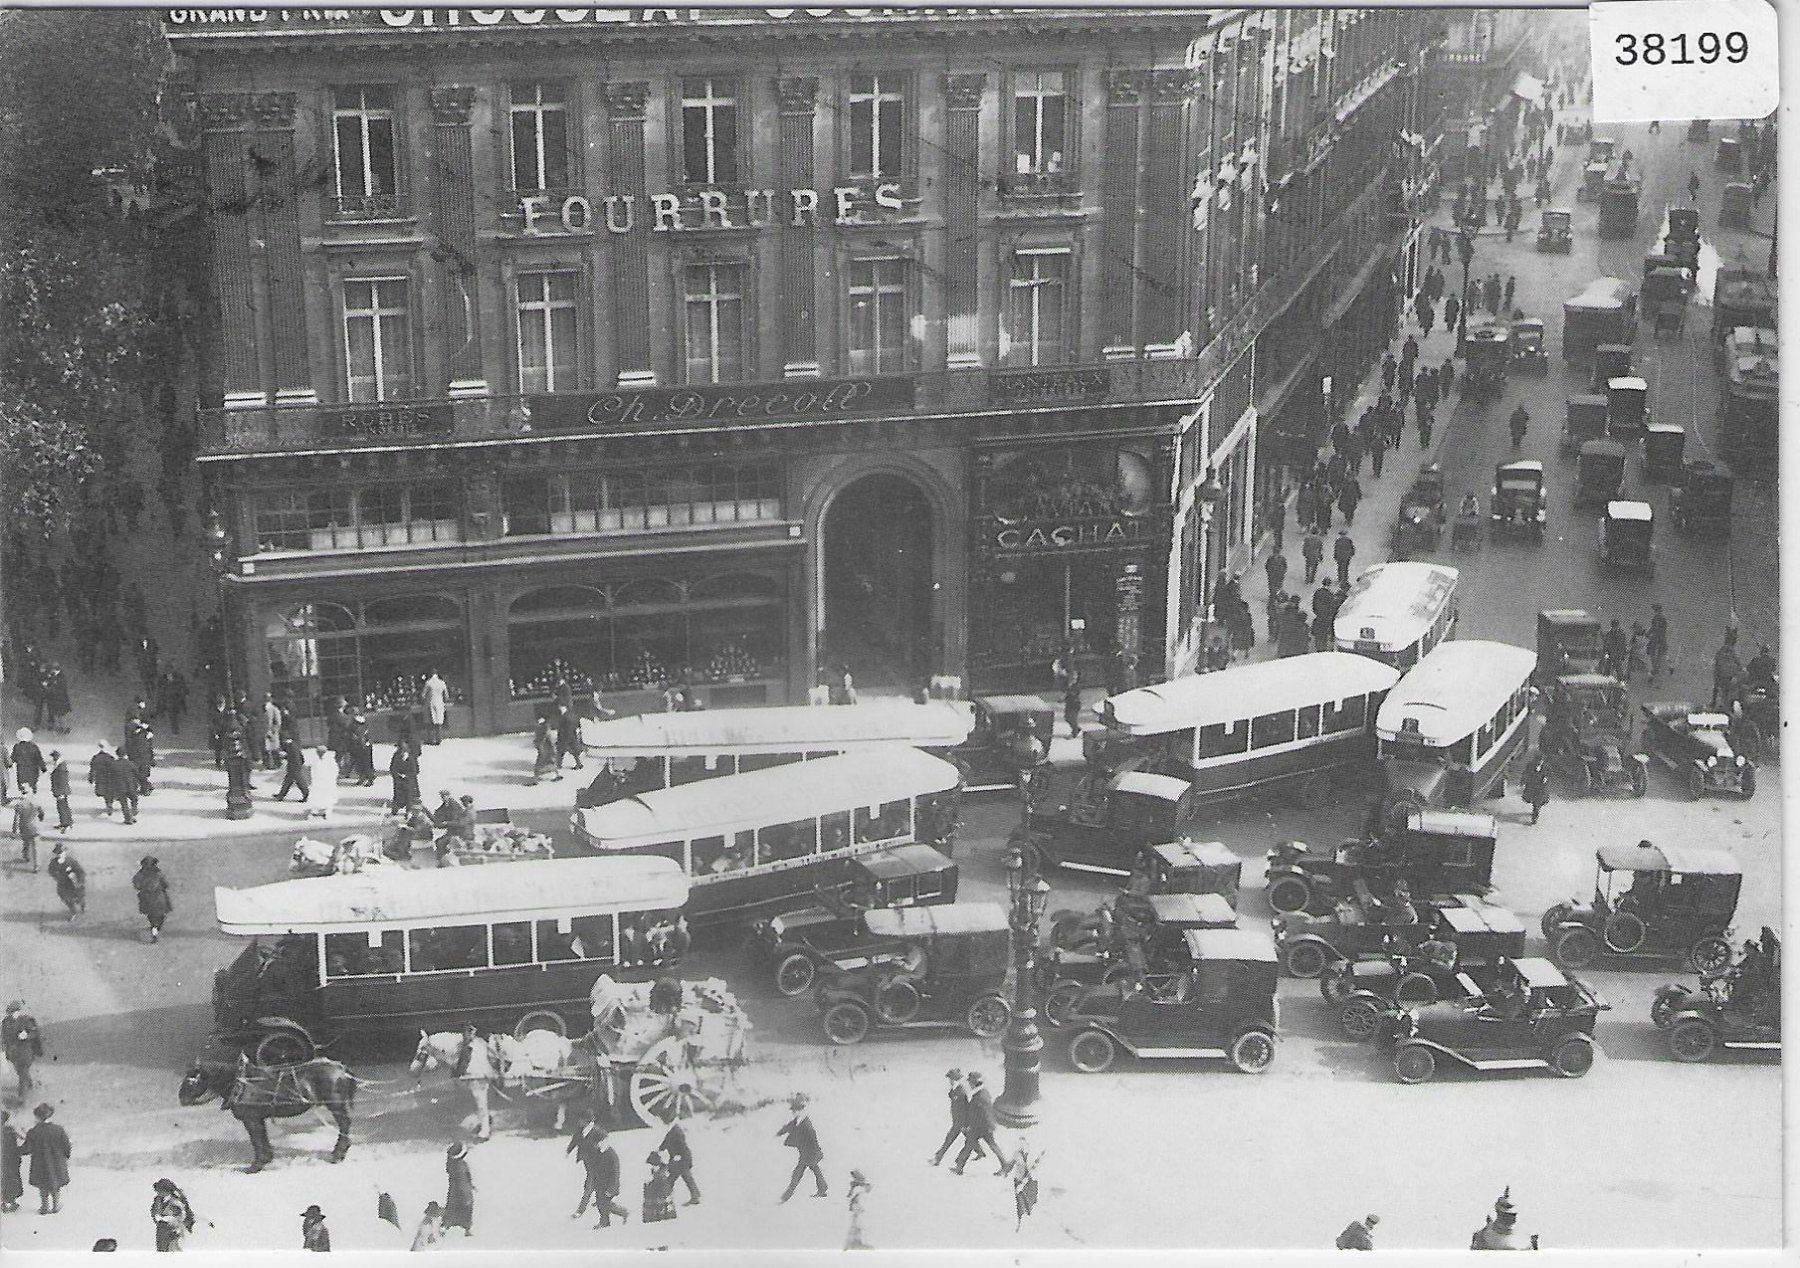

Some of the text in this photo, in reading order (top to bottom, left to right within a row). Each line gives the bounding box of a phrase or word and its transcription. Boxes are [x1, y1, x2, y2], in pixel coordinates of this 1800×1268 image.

[1615, 31, 1749, 66] 38199
[520, 183, 902, 236] FOURRURES
[341, 410, 431, 427] ROBES
[996, 521, 1140, 548] CACHAT
